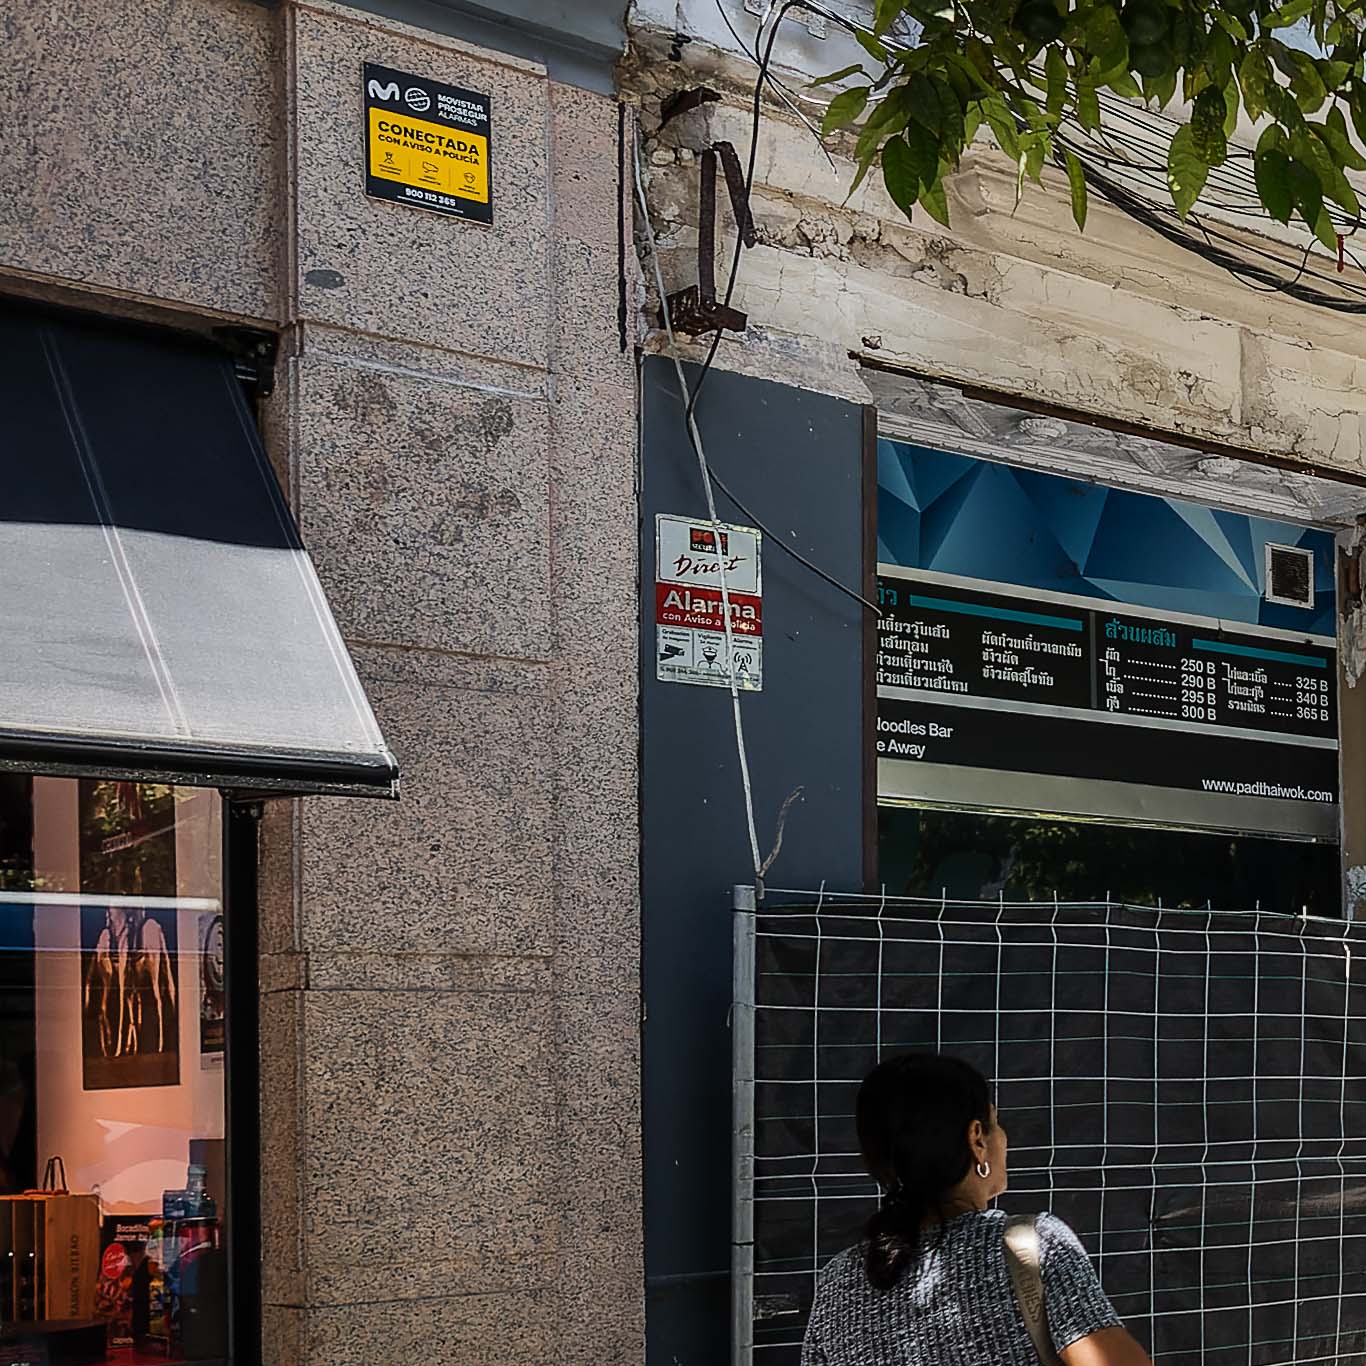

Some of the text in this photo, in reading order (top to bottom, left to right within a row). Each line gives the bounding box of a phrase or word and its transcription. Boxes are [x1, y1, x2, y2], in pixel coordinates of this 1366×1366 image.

[437, 93, 484, 113] MOVISTAR
[438, 102, 488, 122] PROSEGUR
[438, 110, 478, 127] ALARMAS
[378, 120, 480, 156] CONECTADA
[378, 134, 480, 166] CON AVISO A POLICÍA
[405, 188, 423, 199] 900
[424, 192, 437, 203] 112
[663, 590, 756, 619] Alarma
[662, 612, 681, 622] con
[684, 614, 712, 626] Aviso
[714, 618, 722, 626] a
[1180, 658, 1204, 673] 250
[1206, 661, 1216, 675] B
[1181, 673, 1204, 688] 290
[1207, 677, 1216, 690] B
[1296, 676, 1318, 690] 325
[1320, 680, 1329, 692] B
[1181, 689, 1205, 704] 295
[1207, 693, 1216, 705] B
[1296, 691, 1318, 706] 340
[1320, 694, 1329, 707] B
[1181, 704, 1205, 720] 300
[1208, 708, 1216, 721] B
[1296, 706, 1318, 720] 365
[1320, 709, 1329, 721] B
[928, 722, 954, 738] Bar
[887, 738, 926, 759] Away
[1202, 779, 1333, 802] www.padthaiwok.com
